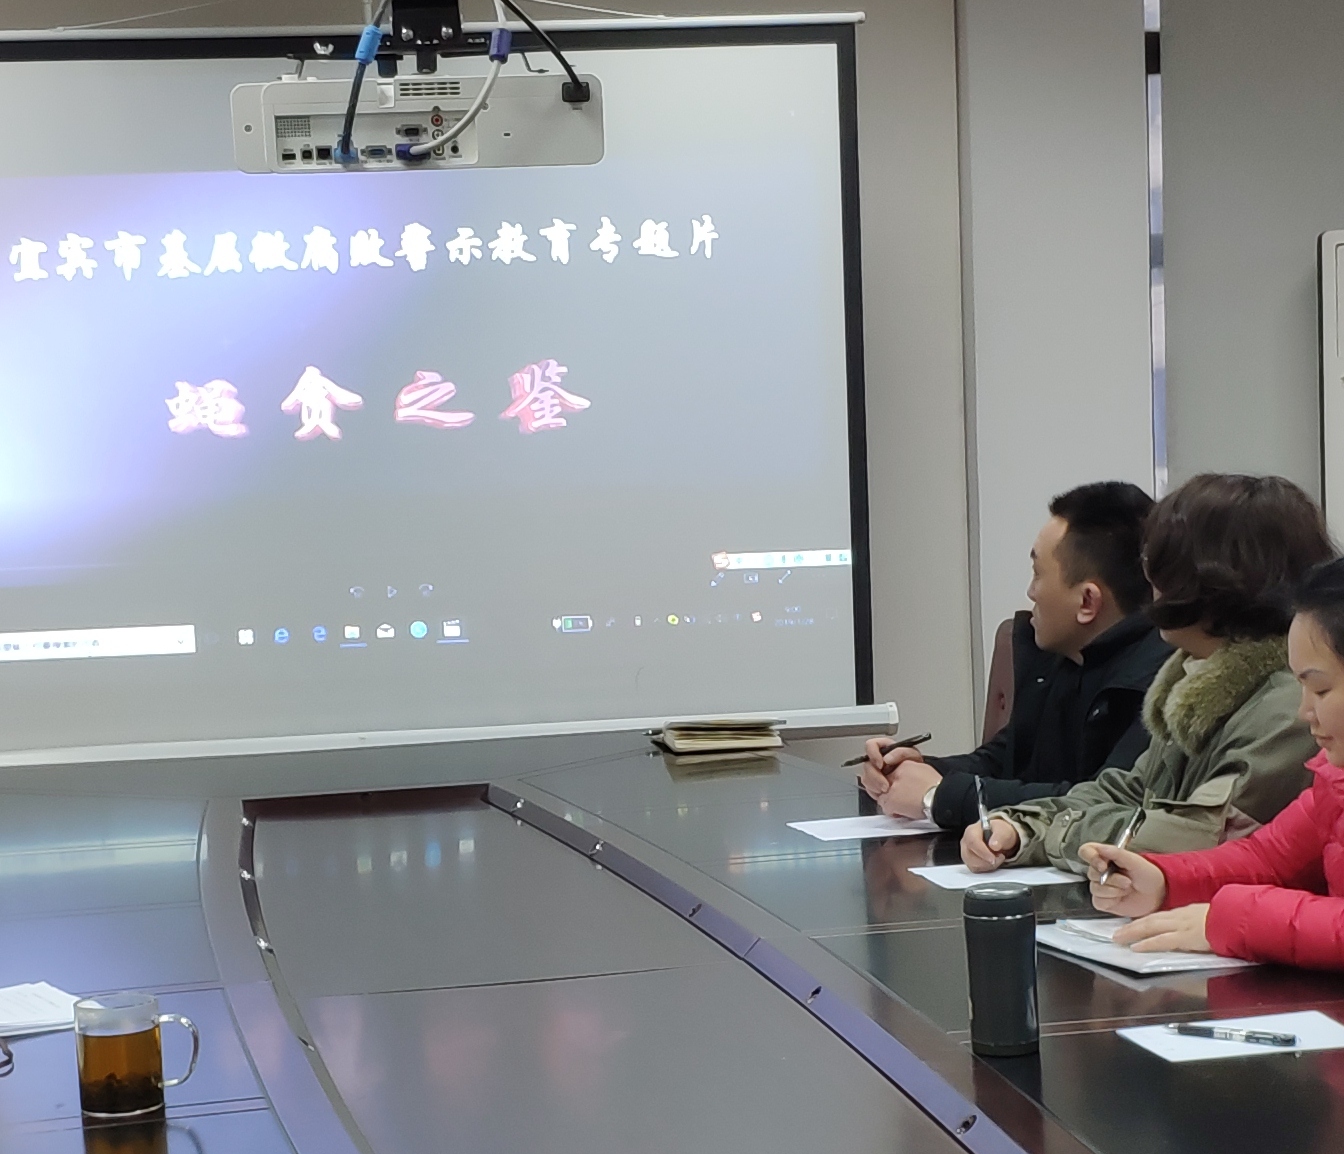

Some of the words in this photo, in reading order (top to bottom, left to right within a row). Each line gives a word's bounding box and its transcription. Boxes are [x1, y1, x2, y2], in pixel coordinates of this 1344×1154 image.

[8, 215, 720, 282] 宜宾市基层微腐败警示教育专题片
[164, 358, 592, 441] 蝇贪之鉴
